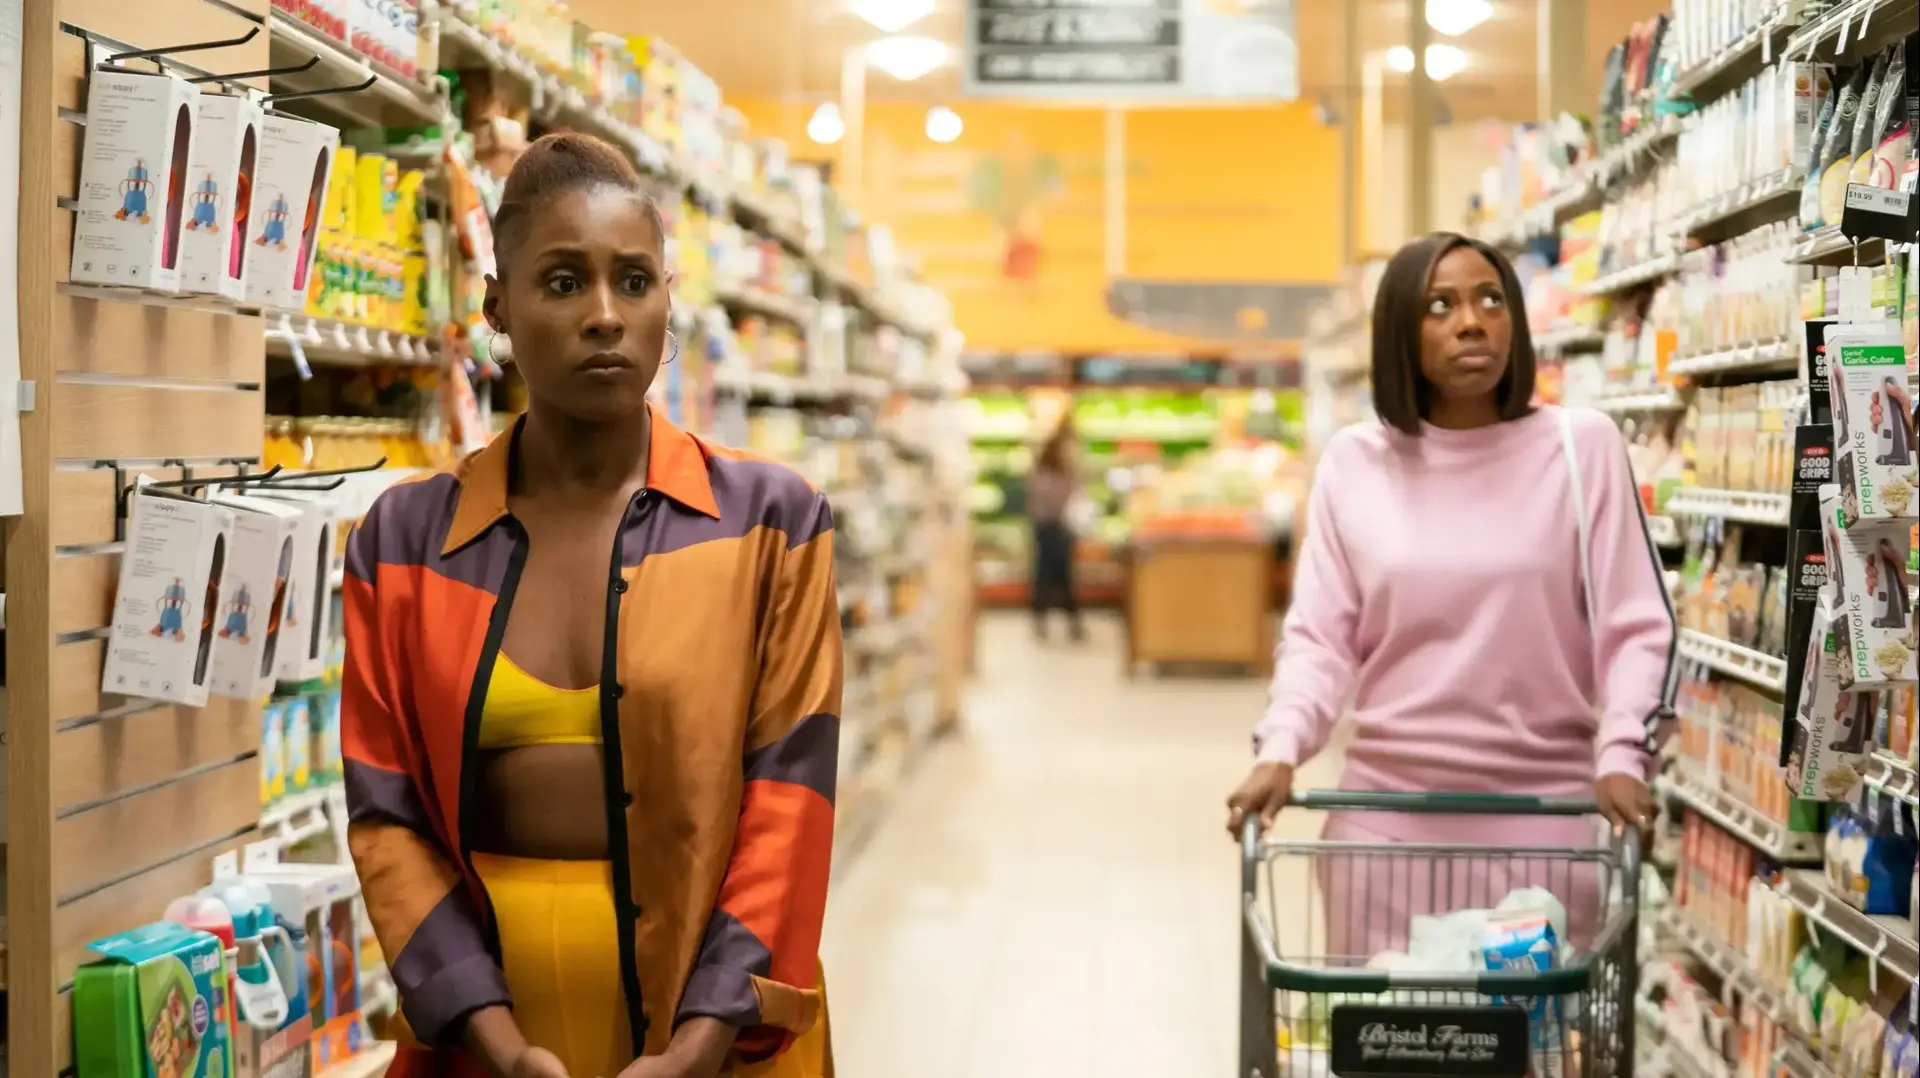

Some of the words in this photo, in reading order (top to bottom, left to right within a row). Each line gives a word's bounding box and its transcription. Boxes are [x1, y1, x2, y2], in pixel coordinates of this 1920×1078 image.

[1848, 190, 1873, 201] $19.99
[1844, 356, 1869, 365] Garlic
[1870, 355, 1895, 364] Cuber
[1800, 457, 1831, 468] GOOD
[1799, 468, 1830, 479] GRIPS
[1854, 431, 1876, 515] prepworks
[1802, 563, 1827, 575] GOO
[1800, 574, 1828, 587] GRIP
[1849, 593, 1873, 679] prepworks
[1803, 716, 1826, 797] prepworks
[1358, 1022, 1428, 1046] Bristol
[1431, 1024, 1499, 1047] Farms
